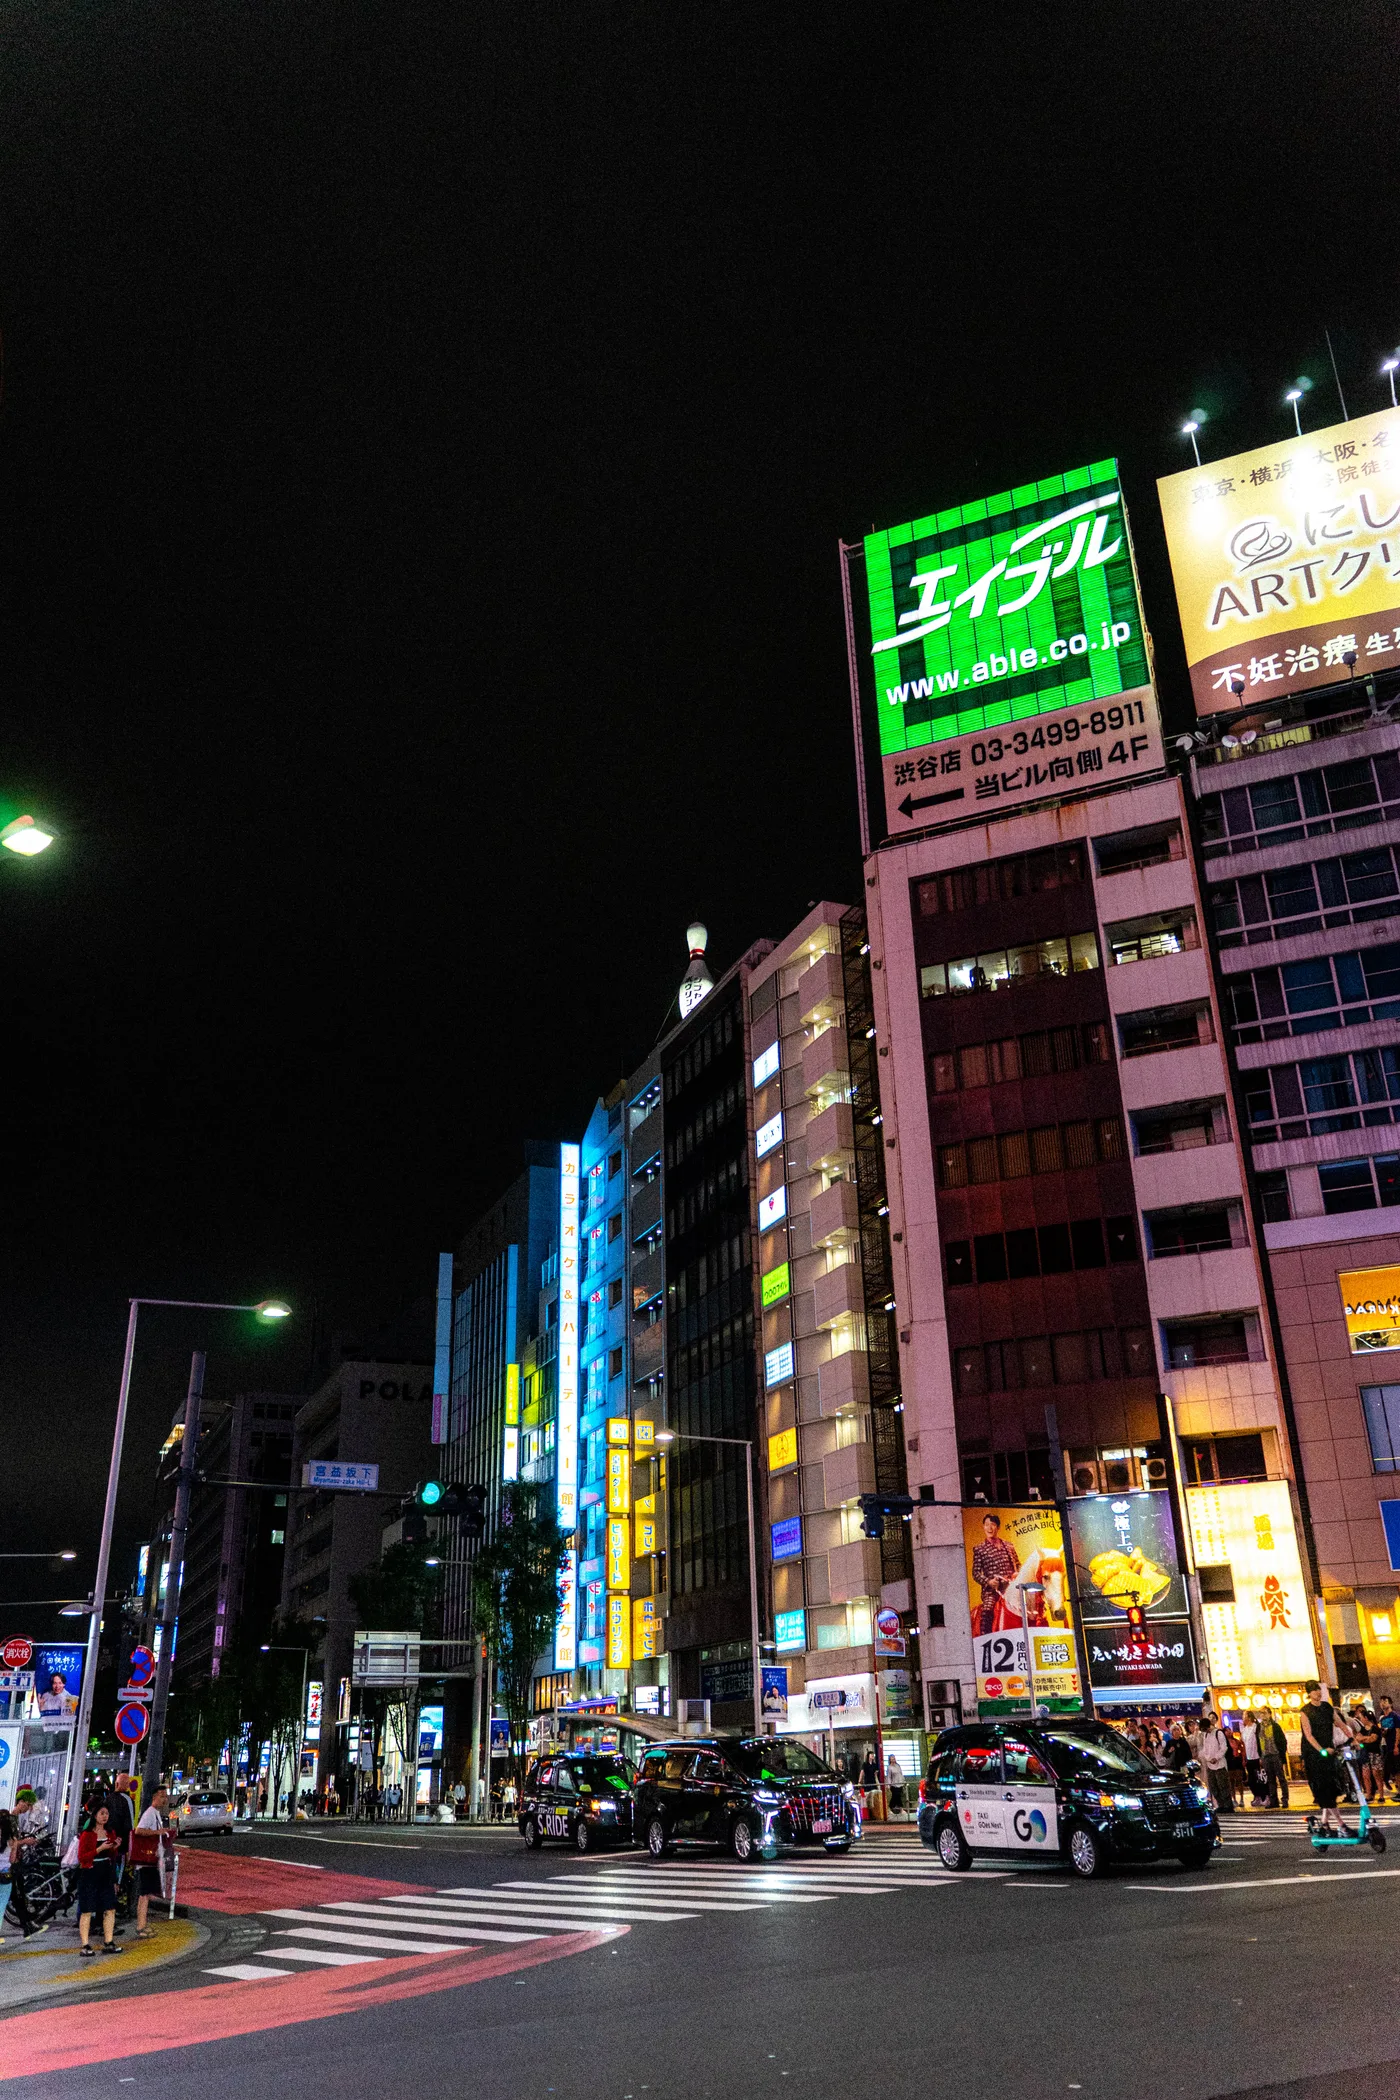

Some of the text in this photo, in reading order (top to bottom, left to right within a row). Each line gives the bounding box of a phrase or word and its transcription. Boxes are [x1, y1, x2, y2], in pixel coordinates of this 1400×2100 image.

[874, 492, 1122, 652] エイブル
[886, 622, 1131, 706] www.able.co.jp
[1211, 633, 1359, 691] 不妊治療
[894, 701, 1146, 787] 渋谷店 03-3499-8911
[975, 736, 1149, 800] 当ビル向側 4F
[316, 1465, 372, 1479] 宮益坂下
[1015, 1523, 1040, 1537] MEGA
[6, 1648, 29, 1659] 消火栓
[981, 1638, 1015, 1673] 12
[1040, 1643, 1069, 1652] MEGA
[1041, 1651, 1070, 1663] BIG
[537, 1813, 569, 1837] S.RIDE
[1013, 1809, 1047, 1842] GO
